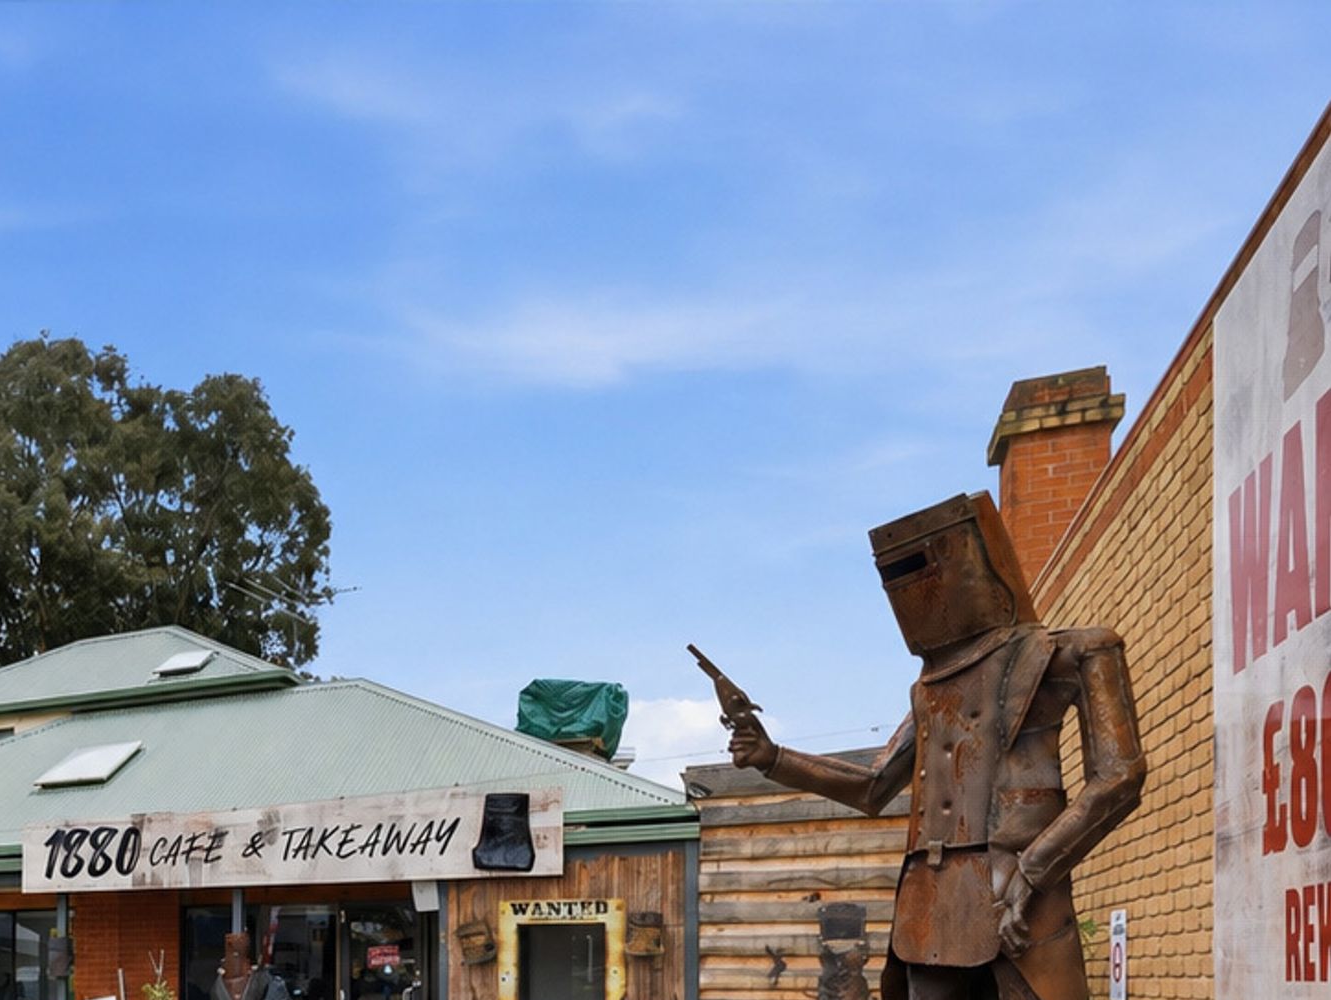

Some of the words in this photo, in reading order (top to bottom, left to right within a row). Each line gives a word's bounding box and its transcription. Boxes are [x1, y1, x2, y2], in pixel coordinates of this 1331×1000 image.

[43, 826, 140, 880] 1880
[149, 828, 228, 866] CAFE
[242, 832, 265, 858] &
[282, 817, 461, 861] TAKEAWAY
[510, 901, 609, 916] WANTED
